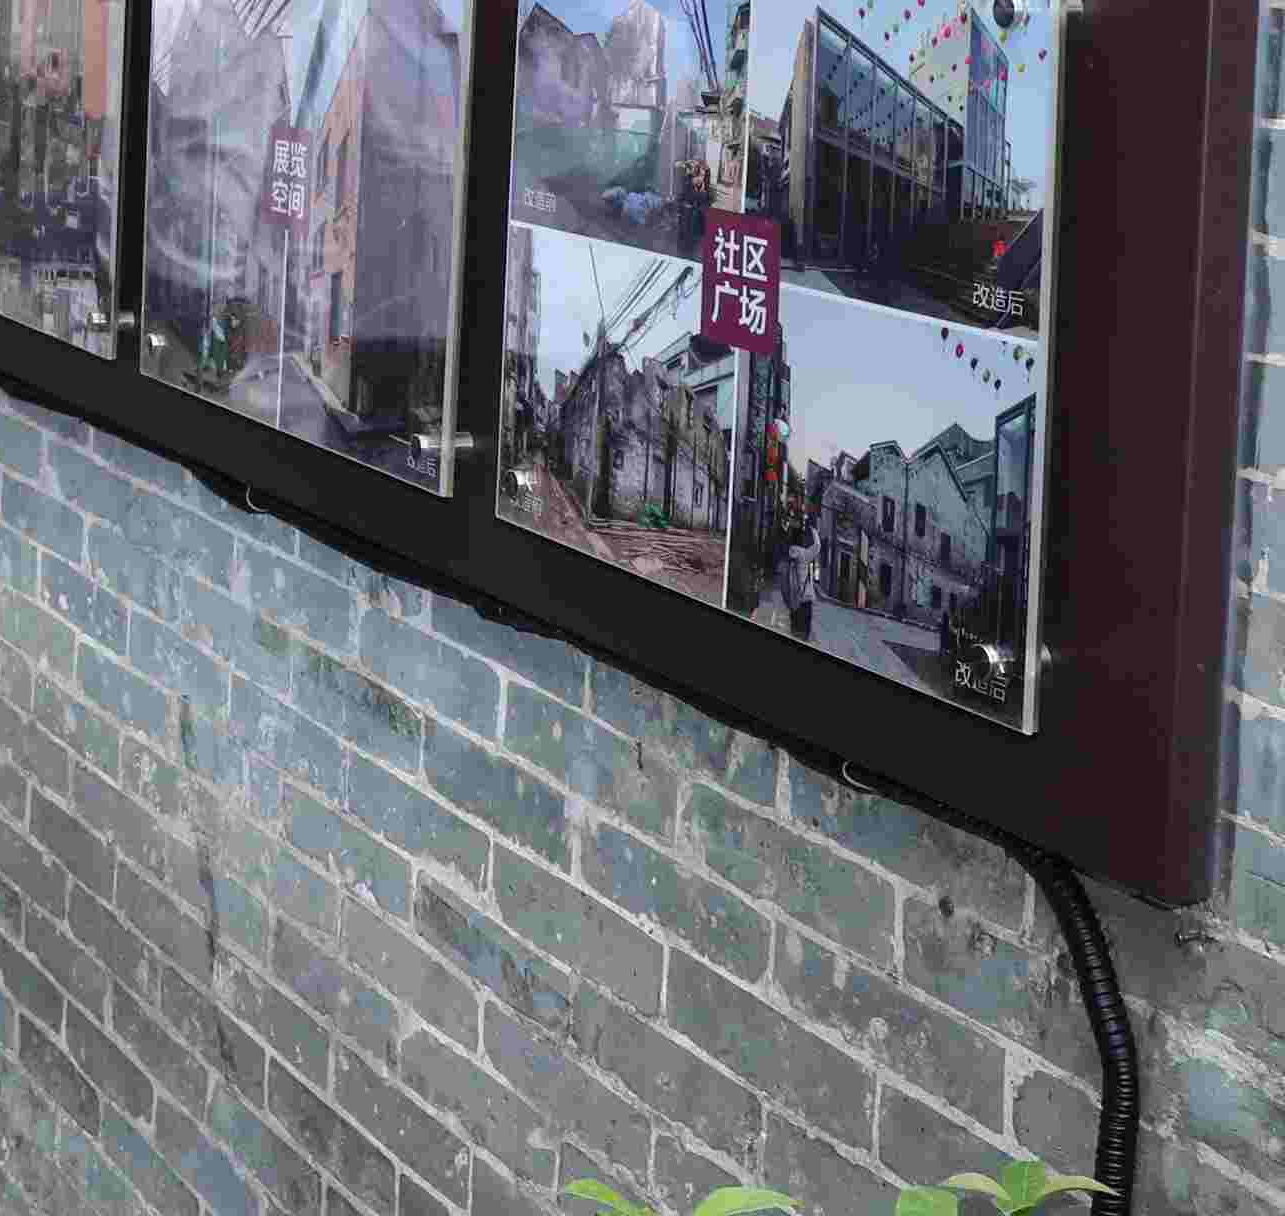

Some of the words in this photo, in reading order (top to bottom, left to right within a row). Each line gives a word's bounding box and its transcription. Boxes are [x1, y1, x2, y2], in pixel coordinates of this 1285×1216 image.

[272, 139, 307, 179] 展览
[269, 178, 305, 219] 空间
[713, 226, 769, 282] 社区
[711, 281, 767, 335] 广场
[972, 281, 1025, 318] 改造后
